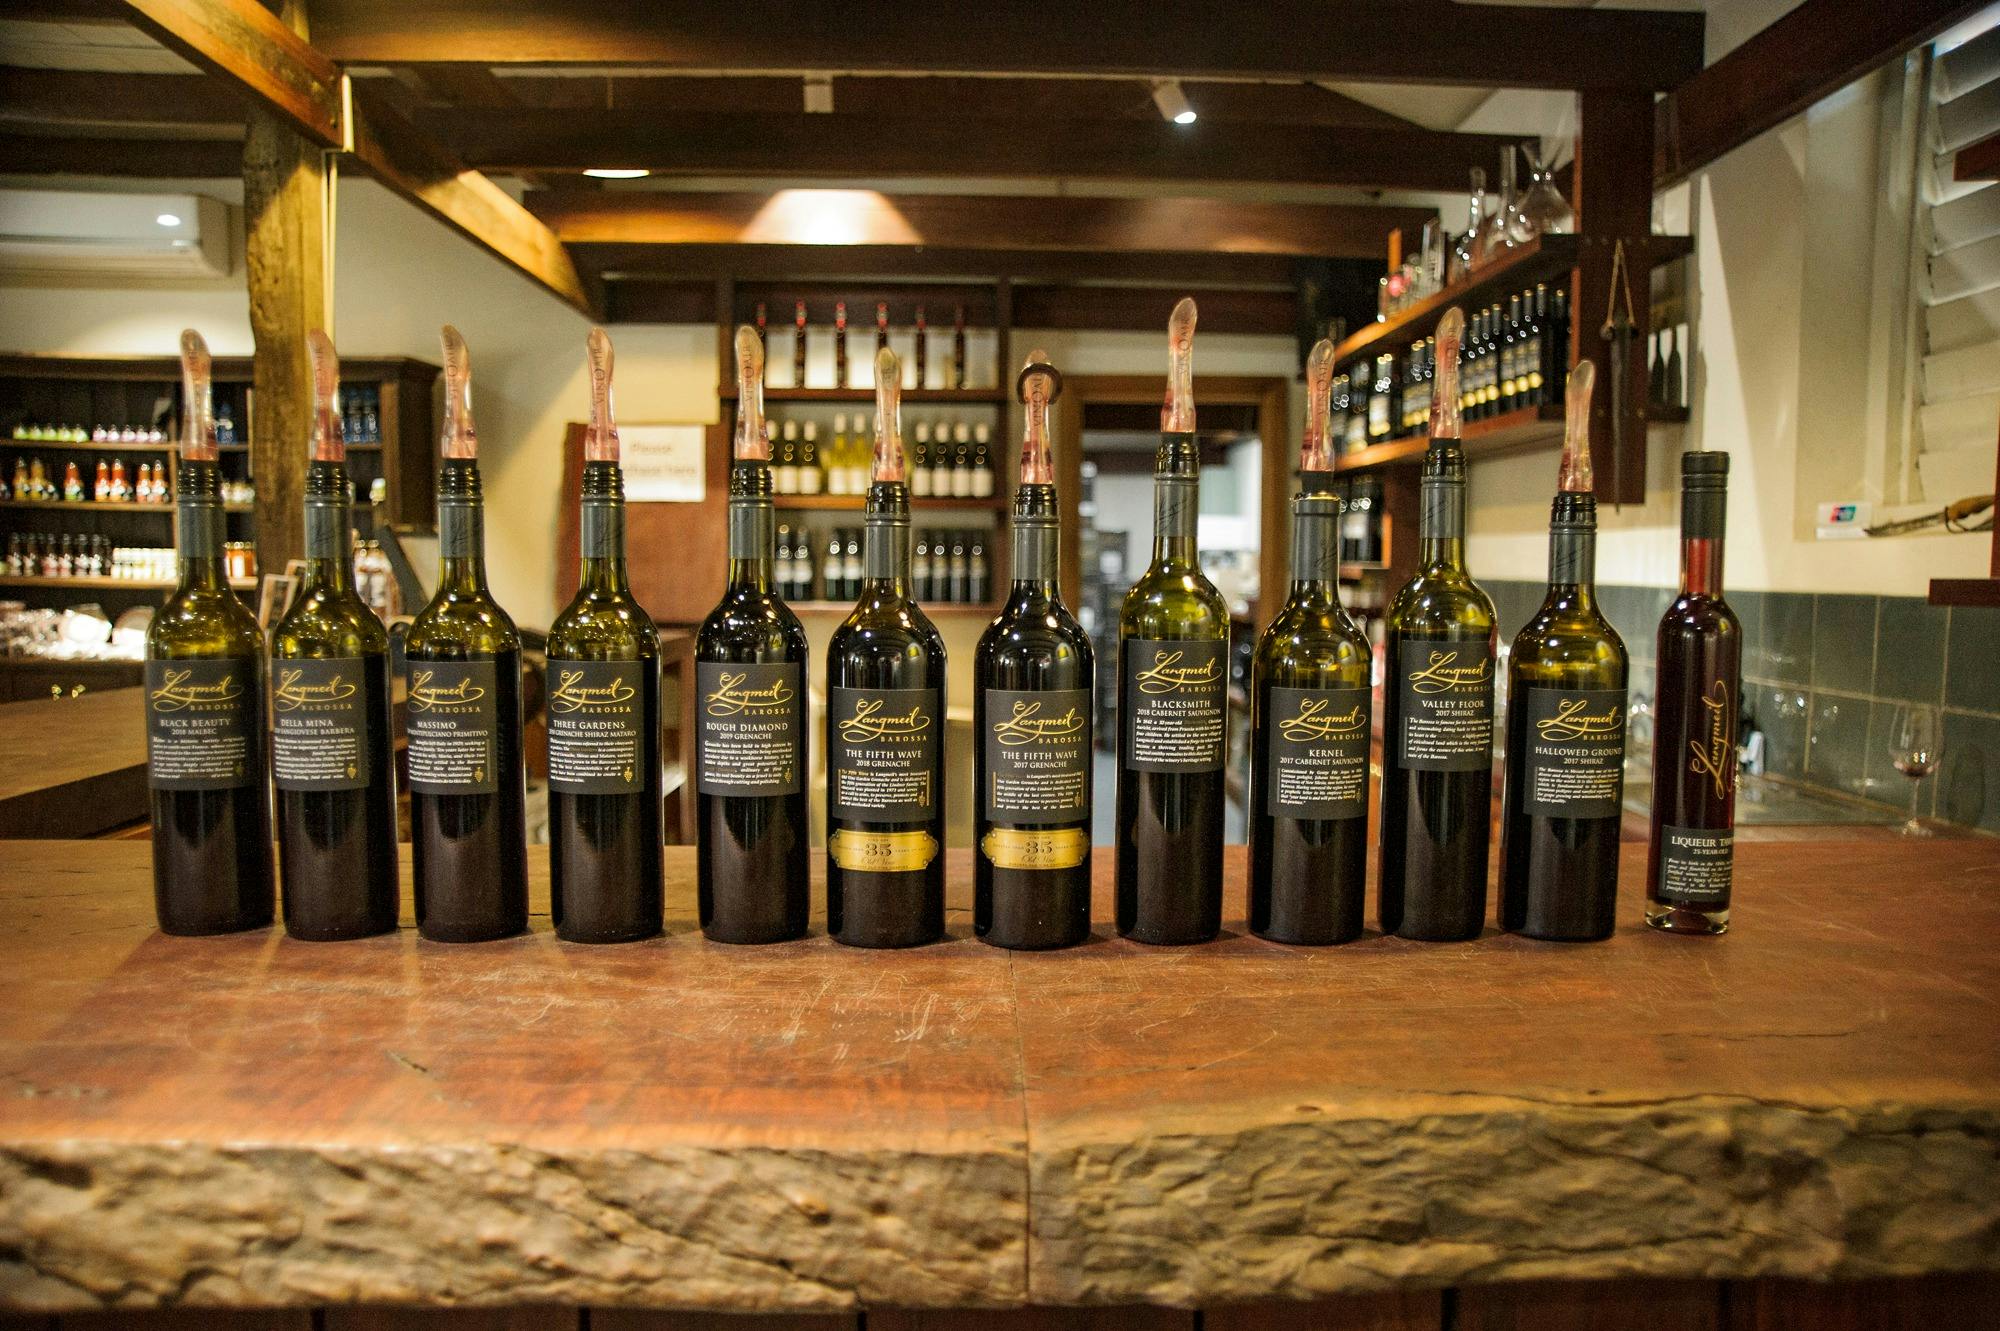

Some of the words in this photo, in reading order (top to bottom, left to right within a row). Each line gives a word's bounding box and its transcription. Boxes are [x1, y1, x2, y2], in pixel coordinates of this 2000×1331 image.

[1031, 375, 1044, 427] VINOAI
[1135, 650, 1223, 693] Langmeil
[1408, 650, 1492, 693] Langmeil
[151, 669, 244, 712] Langmeil
[275, 669, 355, 712] Langmeil
[408, 670, 484, 713] Langmeil
[551, 670, 635, 713] Langmeil
[704, 672, 794, 716] Langmeil
[301, 703, 353, 711] BAROSSA
[1151, 700, 1210, 709] BLACKSMITH
[1422, 700, 1456, 708] VALLEY
[1459, 700, 1484, 708] FLOOR
[744, 707, 791, 716] BAROSSA
[160, 719, 188, 727] BLACK
[191, 718, 231, 727] BEAUTY
[281, 719, 303, 727] DELLA
[306, 719, 334, 727] MINA
[553, 719, 576, 729] THREE
[579, 721, 625, 730] GARDENS
[838, 698, 930, 743] Langmeil
[993, 700, 1084, 745] Langmeil
[1279, 698, 1366, 742] Langmeil
[1536, 698, 1623, 741] Langmeil
[417, 721, 457, 730] MASSIMO
[706, 722, 736, 731] ROUGH
[740, 722, 788, 732] DIAMOND
[320, 727, 355, 735] BARBERA
[453, 730, 488, 738] PRIMITIVO
[584, 730, 609, 738] SHIRAZ
[1038, 736, 1082, 744] BAROSSA
[1689, 680, 1731, 800] Langmeil
[845, 749, 862, 758] THE
[866, 750, 894, 759] FIFTH
[897, 750, 922, 758] WAVE
[1002, 751, 1020, 760] THE
[1024, 752, 1052, 760] FIFTH
[1055, 750, 1078, 760] WAVE
[1309, 749, 1344, 757] KERNEL
[1535, 746, 1588, 756] HALLOWED
[1591, 746, 1622, 756] GROUND
[856, 759, 871, 767] 2018
[871, 760, 910, 768] GRENACHE
[1013, 761, 1028, 769] 2017
[1029, 761, 1067, 769] GRENACHE
[1295, 758, 1330, 766] CABERNET
[1332, 757, 1363, 765] SAUVIGNON
[1671, 835, 1716, 848] LIQUEUR
[866, 843, 892, 857] 35
[1025, 841, 1052, 854] 35
